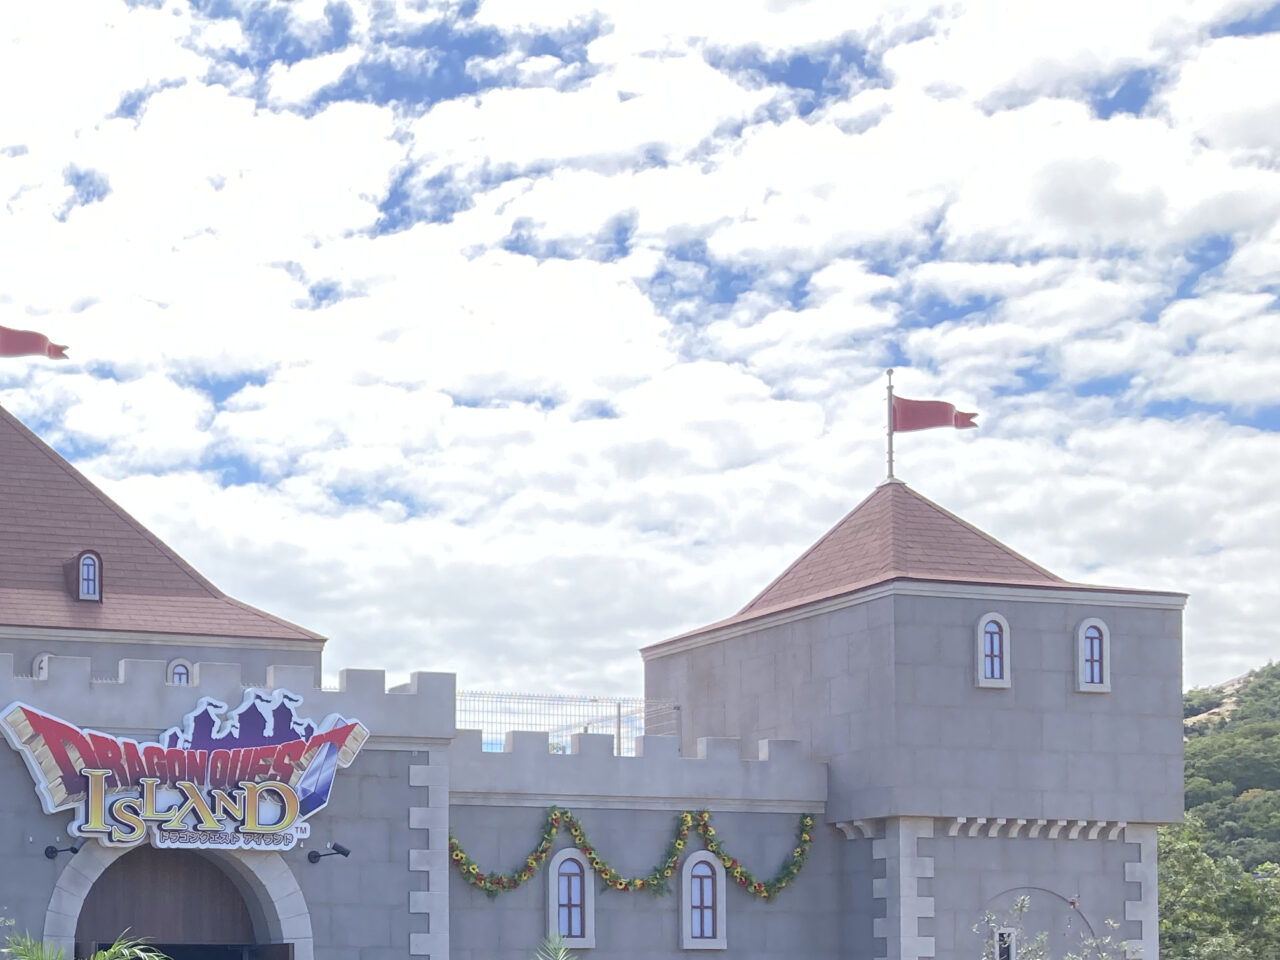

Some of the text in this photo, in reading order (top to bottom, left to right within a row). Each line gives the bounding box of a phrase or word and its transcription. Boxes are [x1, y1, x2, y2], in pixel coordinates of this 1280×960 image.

[6, 705, 207, 806] DRAGON
[79, 768, 300, 842] ISLAND
[159, 831, 293, 846] ドラゴンクエスト アイランド
